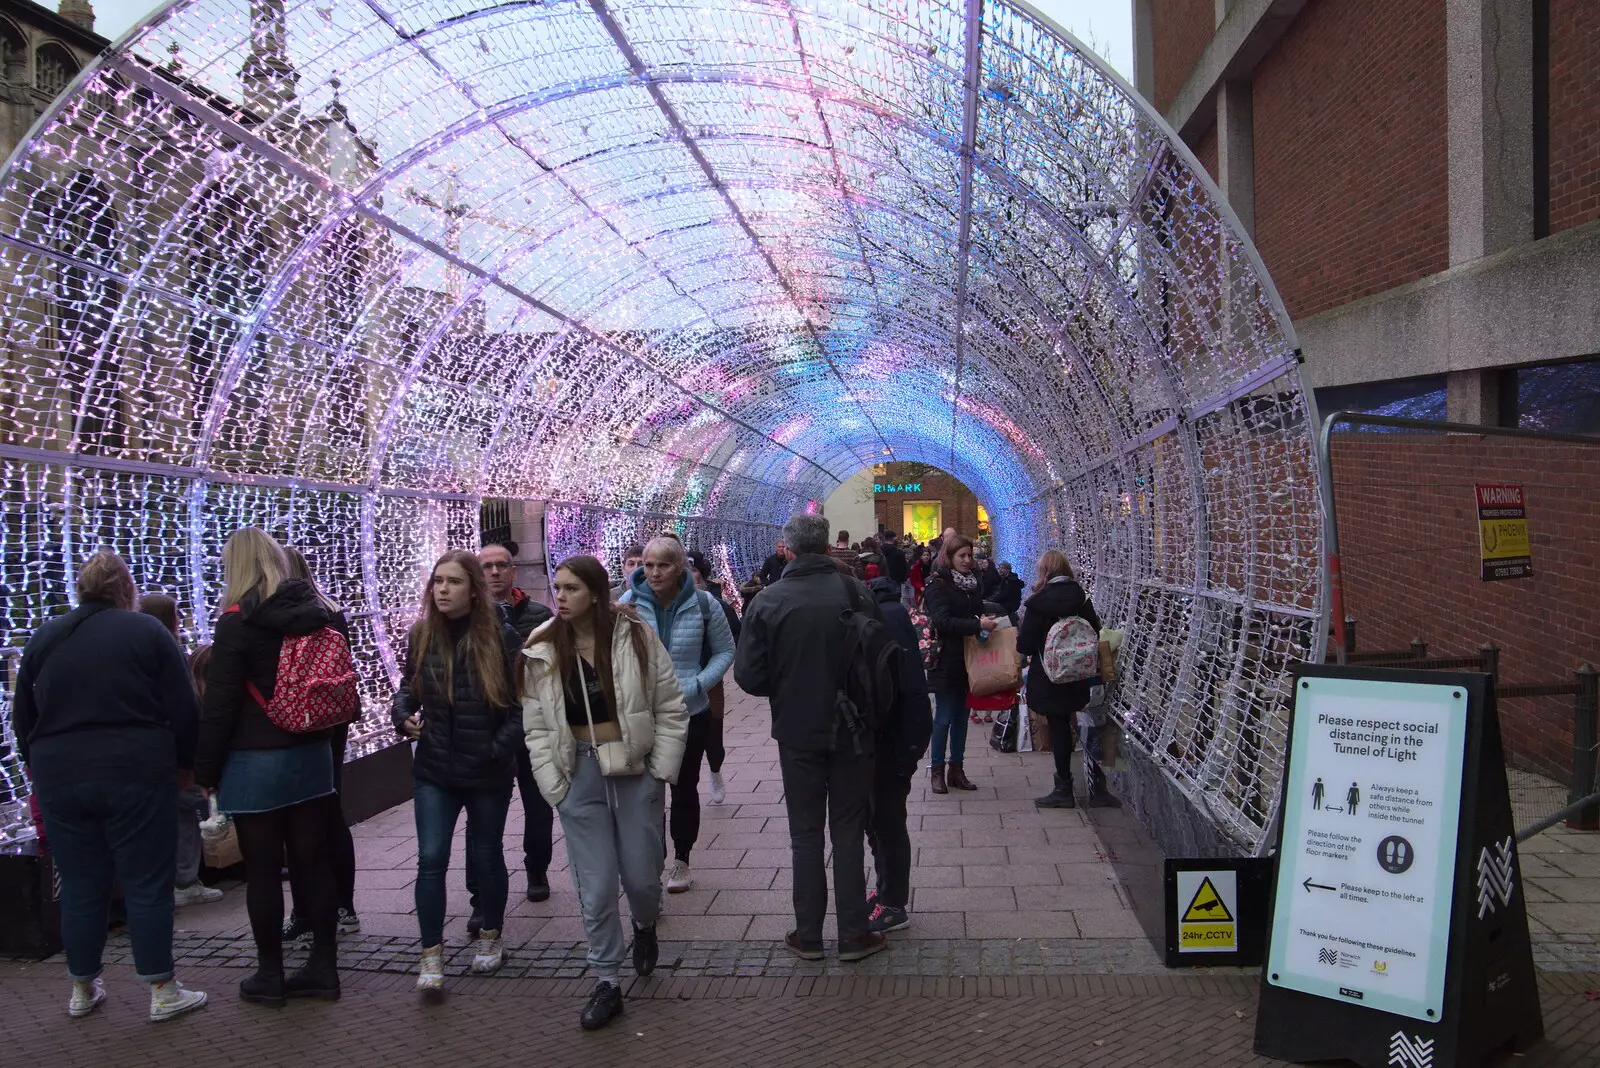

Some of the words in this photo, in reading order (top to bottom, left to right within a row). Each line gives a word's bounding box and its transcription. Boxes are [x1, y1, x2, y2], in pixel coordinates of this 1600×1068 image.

[874, 483, 921, 493] RIMARK
[1480, 487, 1521, 504] WARNING
[1318, 714, 1354, 727] Please
[1356, 718, 1401, 731] respect
[1403, 722, 1439, 734] social
[1330, 728, 1388, 745] distancing
[1390, 733, 1401, 744] in
[1404, 735, 1424, 747] the
[1333, 742, 1370, 756] Tunnel
[1373, 746, 1386, 758] of
[1388, 748, 1417, 762] Light
[1371, 784, 1395, 794] Always
[1396, 785, 1413, 797] keep
[1369, 793, 1384, 802] safe
[1385, 795, 1415, 805] distance
[1416, 798, 1433, 807] from
[1368, 802, 1391, 812] others
[1392, 804, 1411, 814] while
[1368, 811, 1389, 821] inside
[1390, 813, 1401, 822] the
[1402, 815, 1425, 825] tunnel
[1307, 829, 1328, 840] Please
[1329, 832, 1349, 842] follow
[1350, 834, 1362, 844] the
[1306, 839, 1335, 849] direction
[1337, 842, 1344, 850] of
[1345, 843, 1356, 852] the
[1306, 848, 1321, 857] floor
[1322, 850, 1348, 861] markers
[1340, 882, 1362, 894] Please
[1363, 885, 1381, 898] keep
[1382, 888, 1389, 897] to
[1390, 889, 1402, 899] the
[1403, 892, 1415, 902] left
[1416, 895, 1424, 903] at
[1340, 891, 1348, 900] all
[1349, 893, 1369, 904] times.
[1299, 928, 1316, 938] Thank
[1317, 932, 1328, 942] you
[1328, 933, 1338, 942] for
[1338, 935, 1366, 949] following
[1367, 940, 1384, 951] these
[1384, 944, 1416, 958] guidelines
[1340, 951, 1361, 961] Norwich
